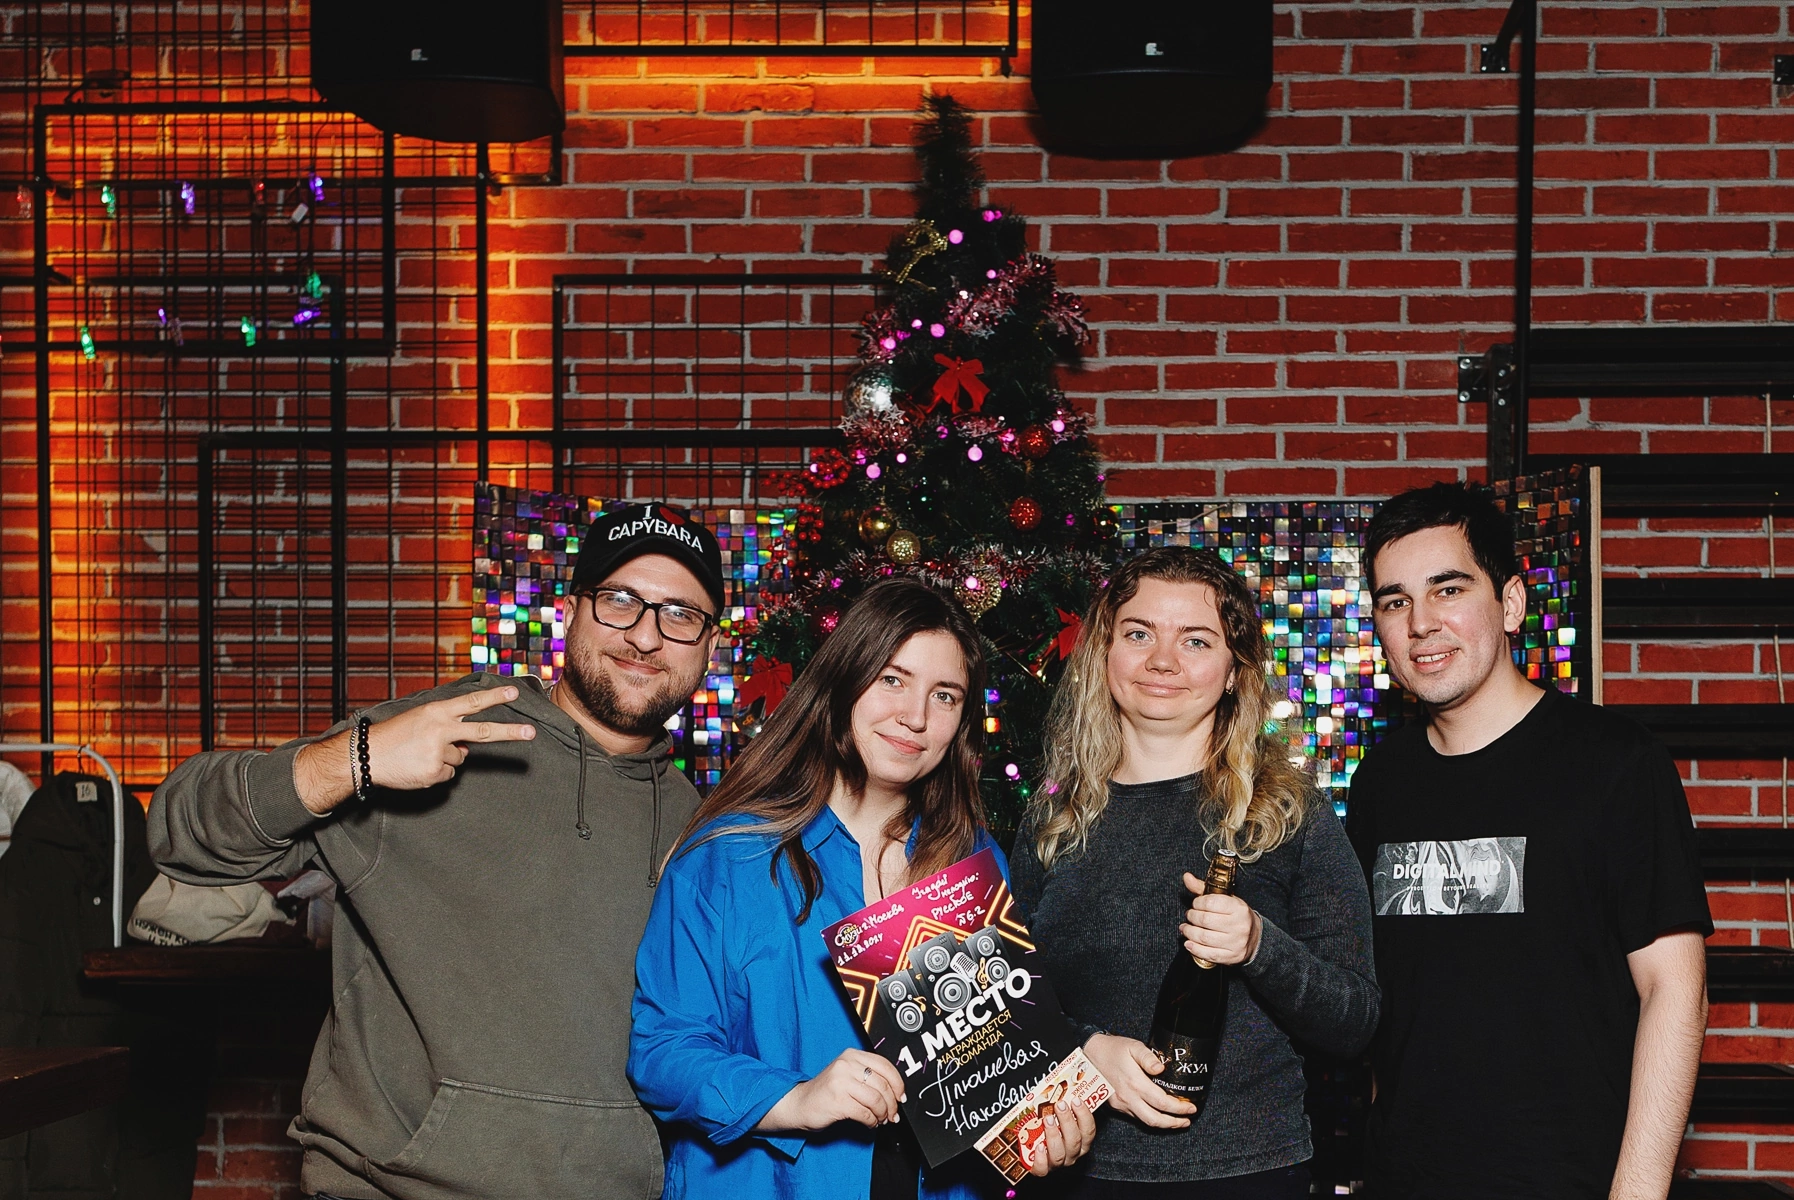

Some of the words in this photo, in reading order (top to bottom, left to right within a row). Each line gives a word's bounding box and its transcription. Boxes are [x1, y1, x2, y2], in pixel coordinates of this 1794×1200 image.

[642, 504, 653, 520] I
[608, 518, 704, 553] CAPYBARA
[898, 1045, 923, 1078] 1
[920, 967, 1032, 1062] МЕСТО
[939, 1009, 1012, 1069] НАГРАЖДАЕТСЯ
[955, 1029, 1004, 1068] КОМАНДА
